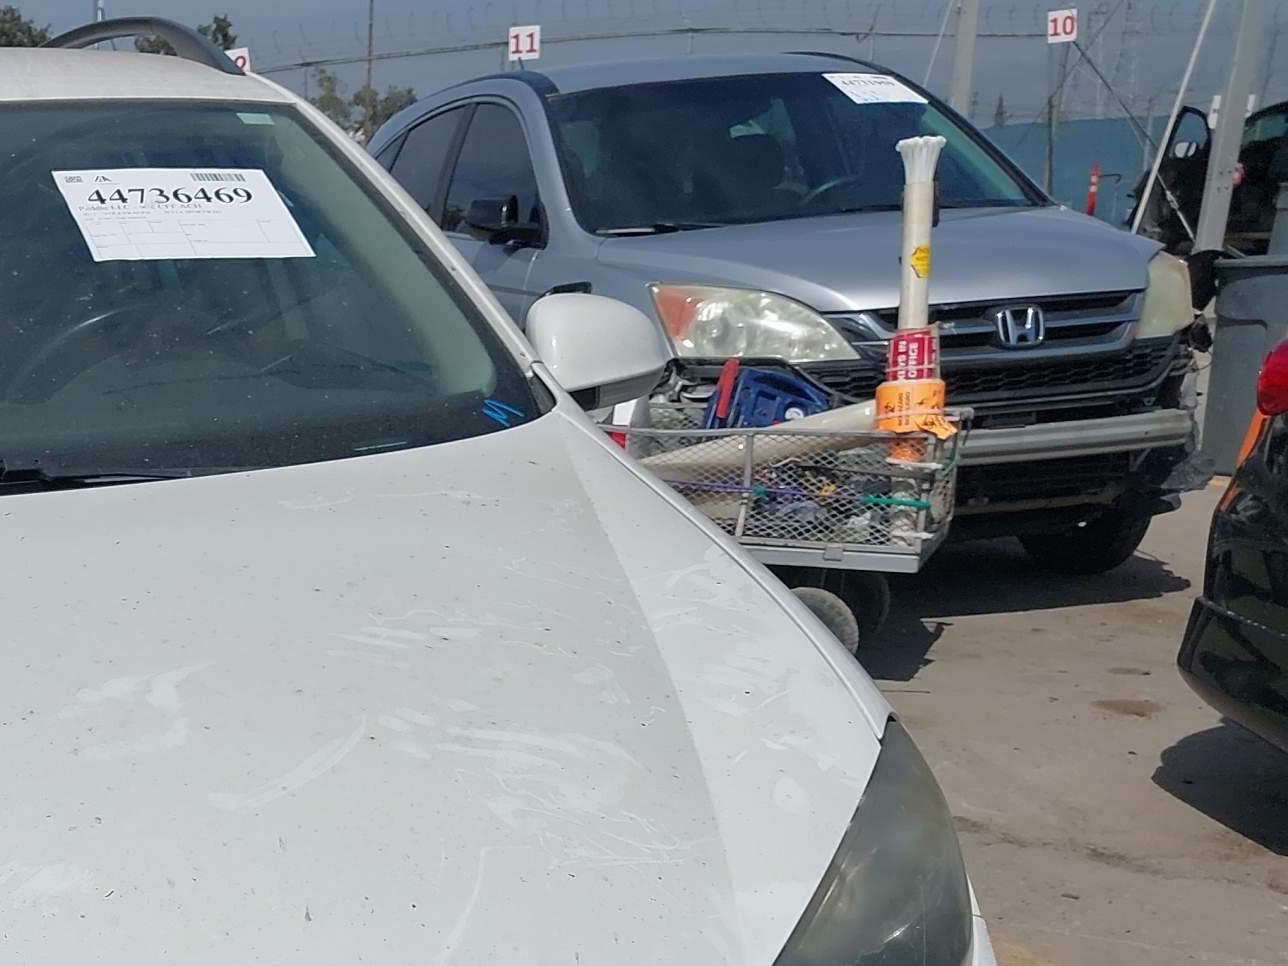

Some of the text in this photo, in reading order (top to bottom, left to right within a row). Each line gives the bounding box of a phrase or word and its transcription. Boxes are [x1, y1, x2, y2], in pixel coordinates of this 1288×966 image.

[1049, 15, 1075, 37] 10
[511, 32, 537, 54] 11
[87, 187, 253, 205] 44736469
